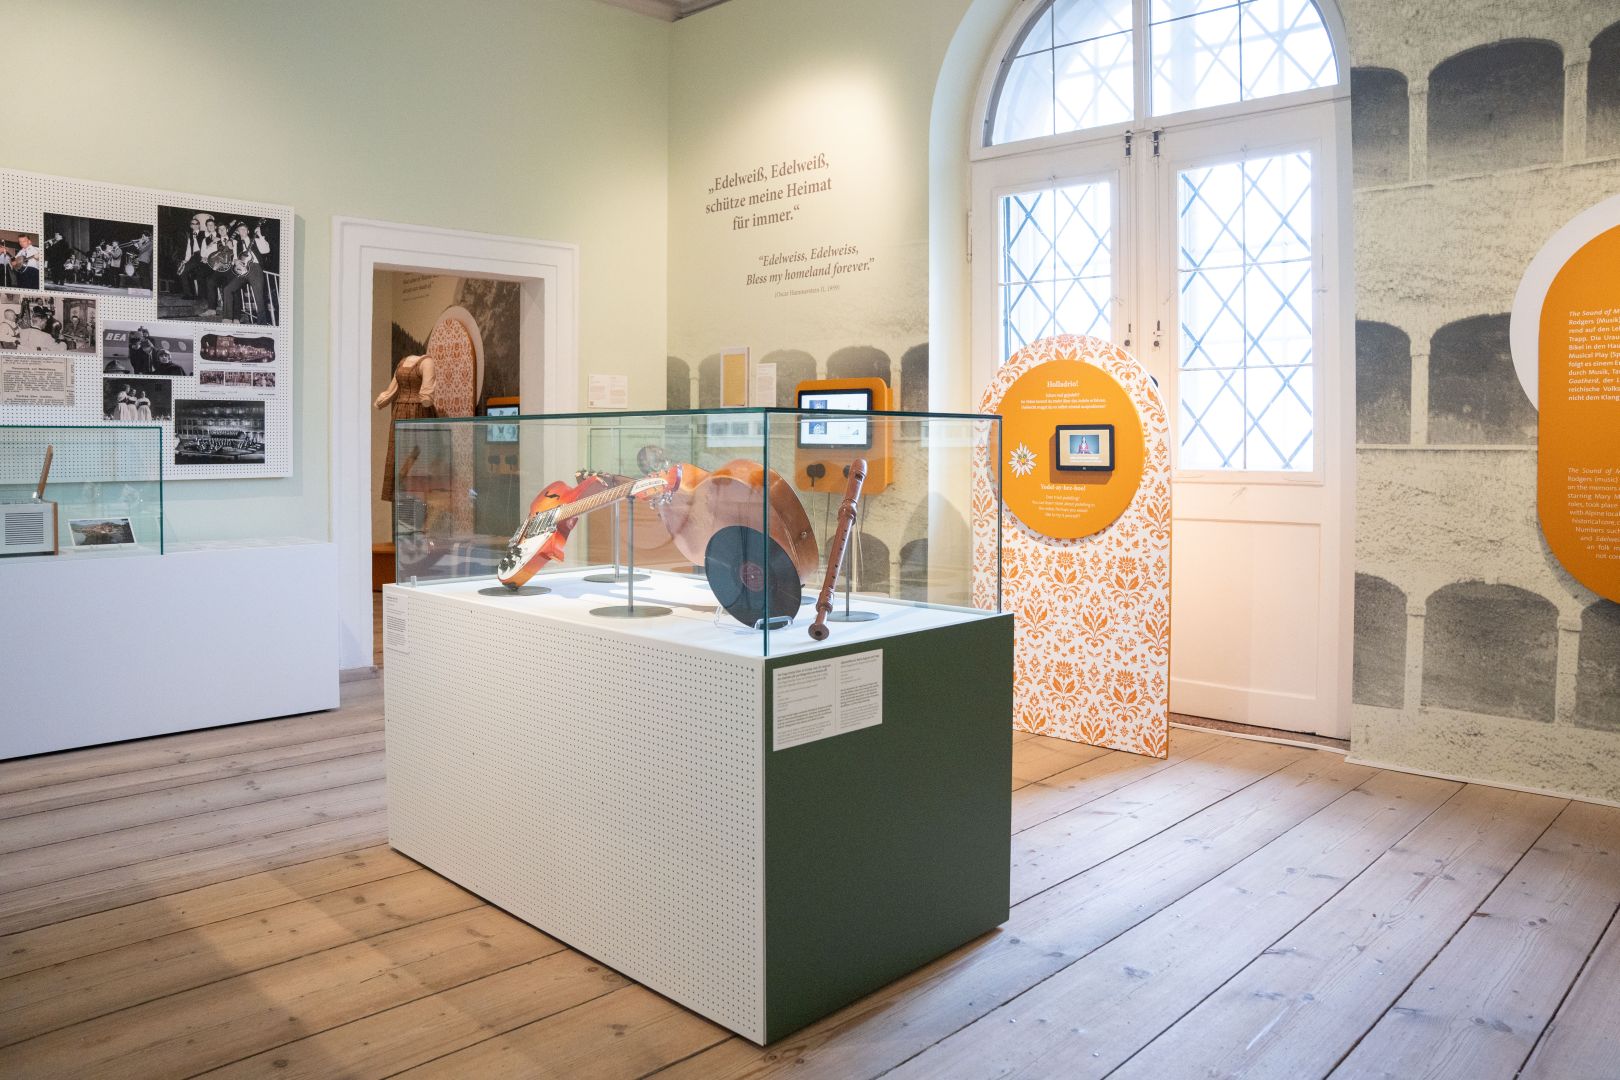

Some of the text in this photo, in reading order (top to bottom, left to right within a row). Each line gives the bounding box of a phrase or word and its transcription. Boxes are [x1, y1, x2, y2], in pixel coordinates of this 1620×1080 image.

[708, 153, 829, 194] „Edelweiß, Edelweiß,
[705, 178, 832, 214] schütze meine Heimat
[732, 204, 800, 230] für immer.“
[758, 243, 858, 267] “Edelweiss, Edelweiss,
[746, 257, 874, 286] Bless my homeland forever.”
[105, 332, 126, 341] BEA
